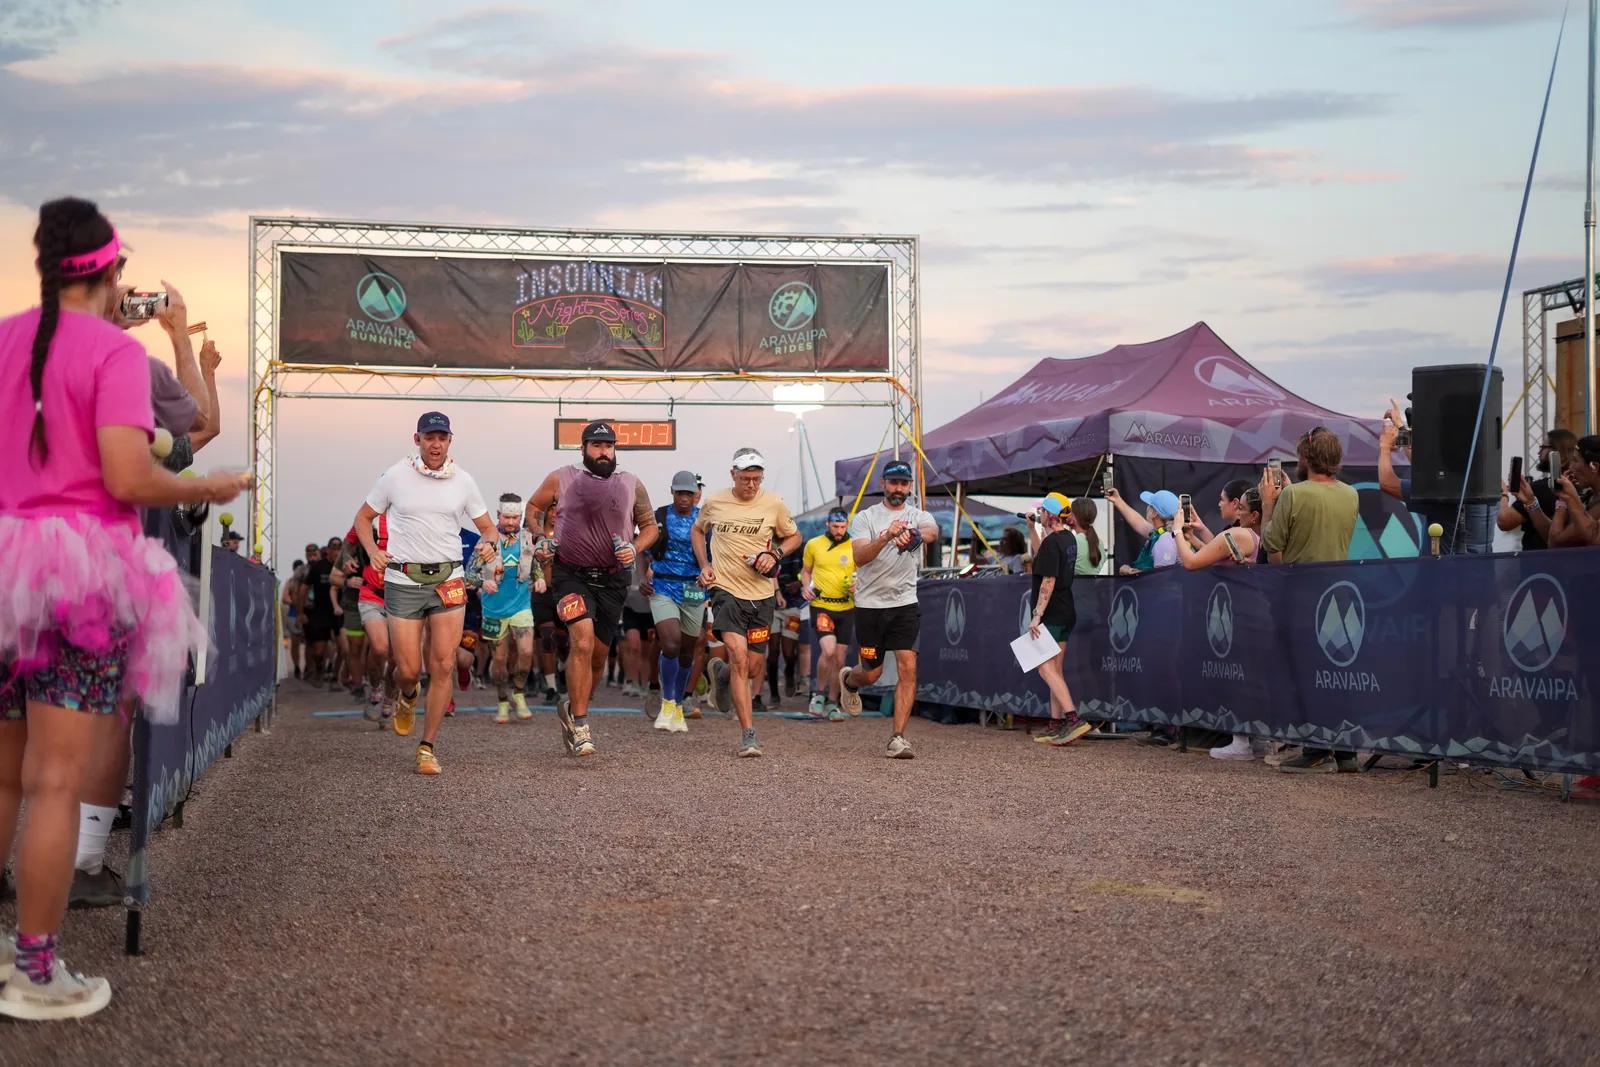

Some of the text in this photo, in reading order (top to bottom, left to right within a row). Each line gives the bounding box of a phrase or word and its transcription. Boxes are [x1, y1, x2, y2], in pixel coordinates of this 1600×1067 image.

[516, 262, 663, 307] INSOMNIAC
[528, 298, 648, 335] Night Series
[346, 318, 417, 342] ARAVAIPA
[759, 328, 828, 349] ARAVAIPA
[350, 331, 412, 350] RUNNING
[775, 342, 813, 356] RIDES
[1145, 432, 1211, 449] ARAVAIPA
[447, 588, 464, 598] 155
[563, 600, 579, 614] 177
[751, 630, 768, 639] 100
[1102, 656, 1142, 673] ARAVAIPA
[1202, 660, 1245, 681] ARAVAIPA
[1315, 670, 1380, 692] ARAVAIPA
[1489, 676, 1579, 700] ARAVAIPA
